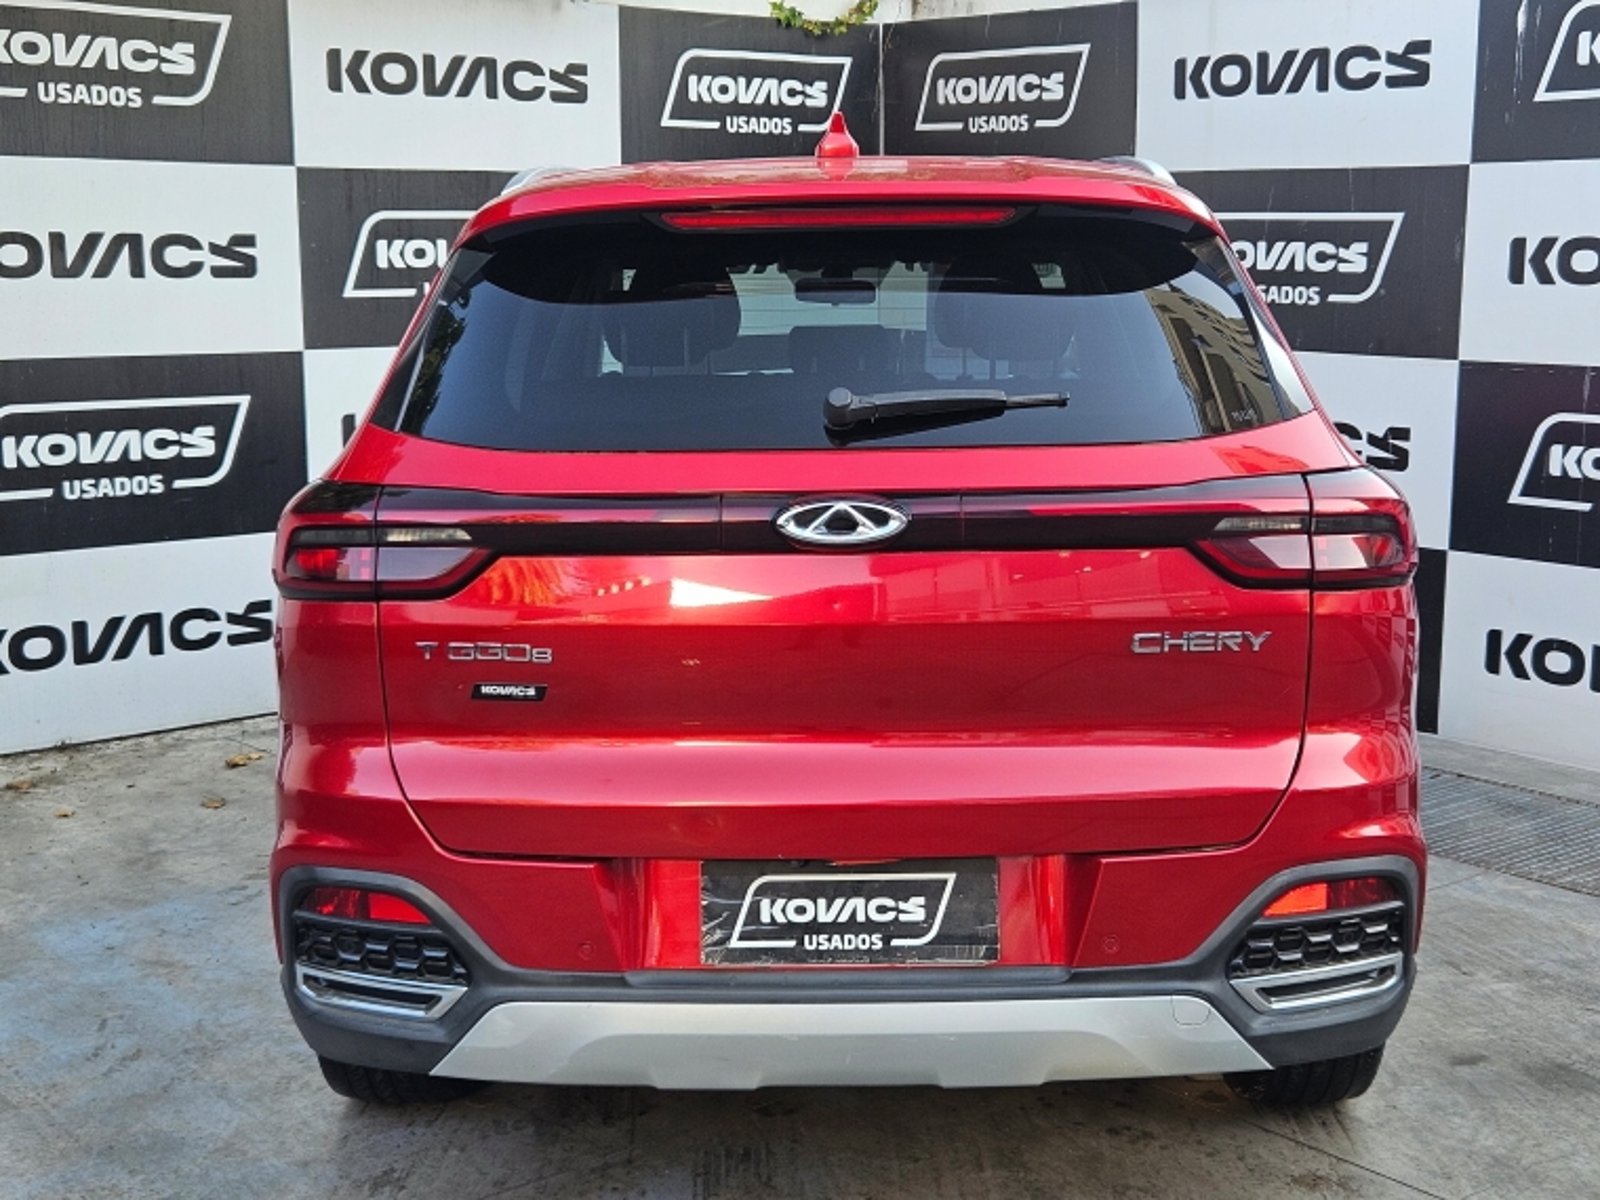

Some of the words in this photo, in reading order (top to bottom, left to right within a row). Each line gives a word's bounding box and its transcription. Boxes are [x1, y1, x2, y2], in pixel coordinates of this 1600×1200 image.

[326, 47, 589, 104] KOVACS
[1173, 39, 1433, 101] KOVACS
[37, 81, 143, 108] USADOS
[687, 74, 828, 108] KOVACS
[936, 71, 1065, 105] KOVACS
[725, 115, 793, 135] USADOS
[968, 114, 1029, 134] USADOS
[1, 425, 216, 469] KOVACS
[62, 474, 165, 500] USADOS
[0, 599, 272, 677] OVACS
[1131, 631, 1272, 653] CHERY
[1484, 628, 1600, 694] KO
[480, 685, 536, 696] KOVACS
[759, 896, 926, 924] KOVACS
[803, 934, 883, 950] USADOS
